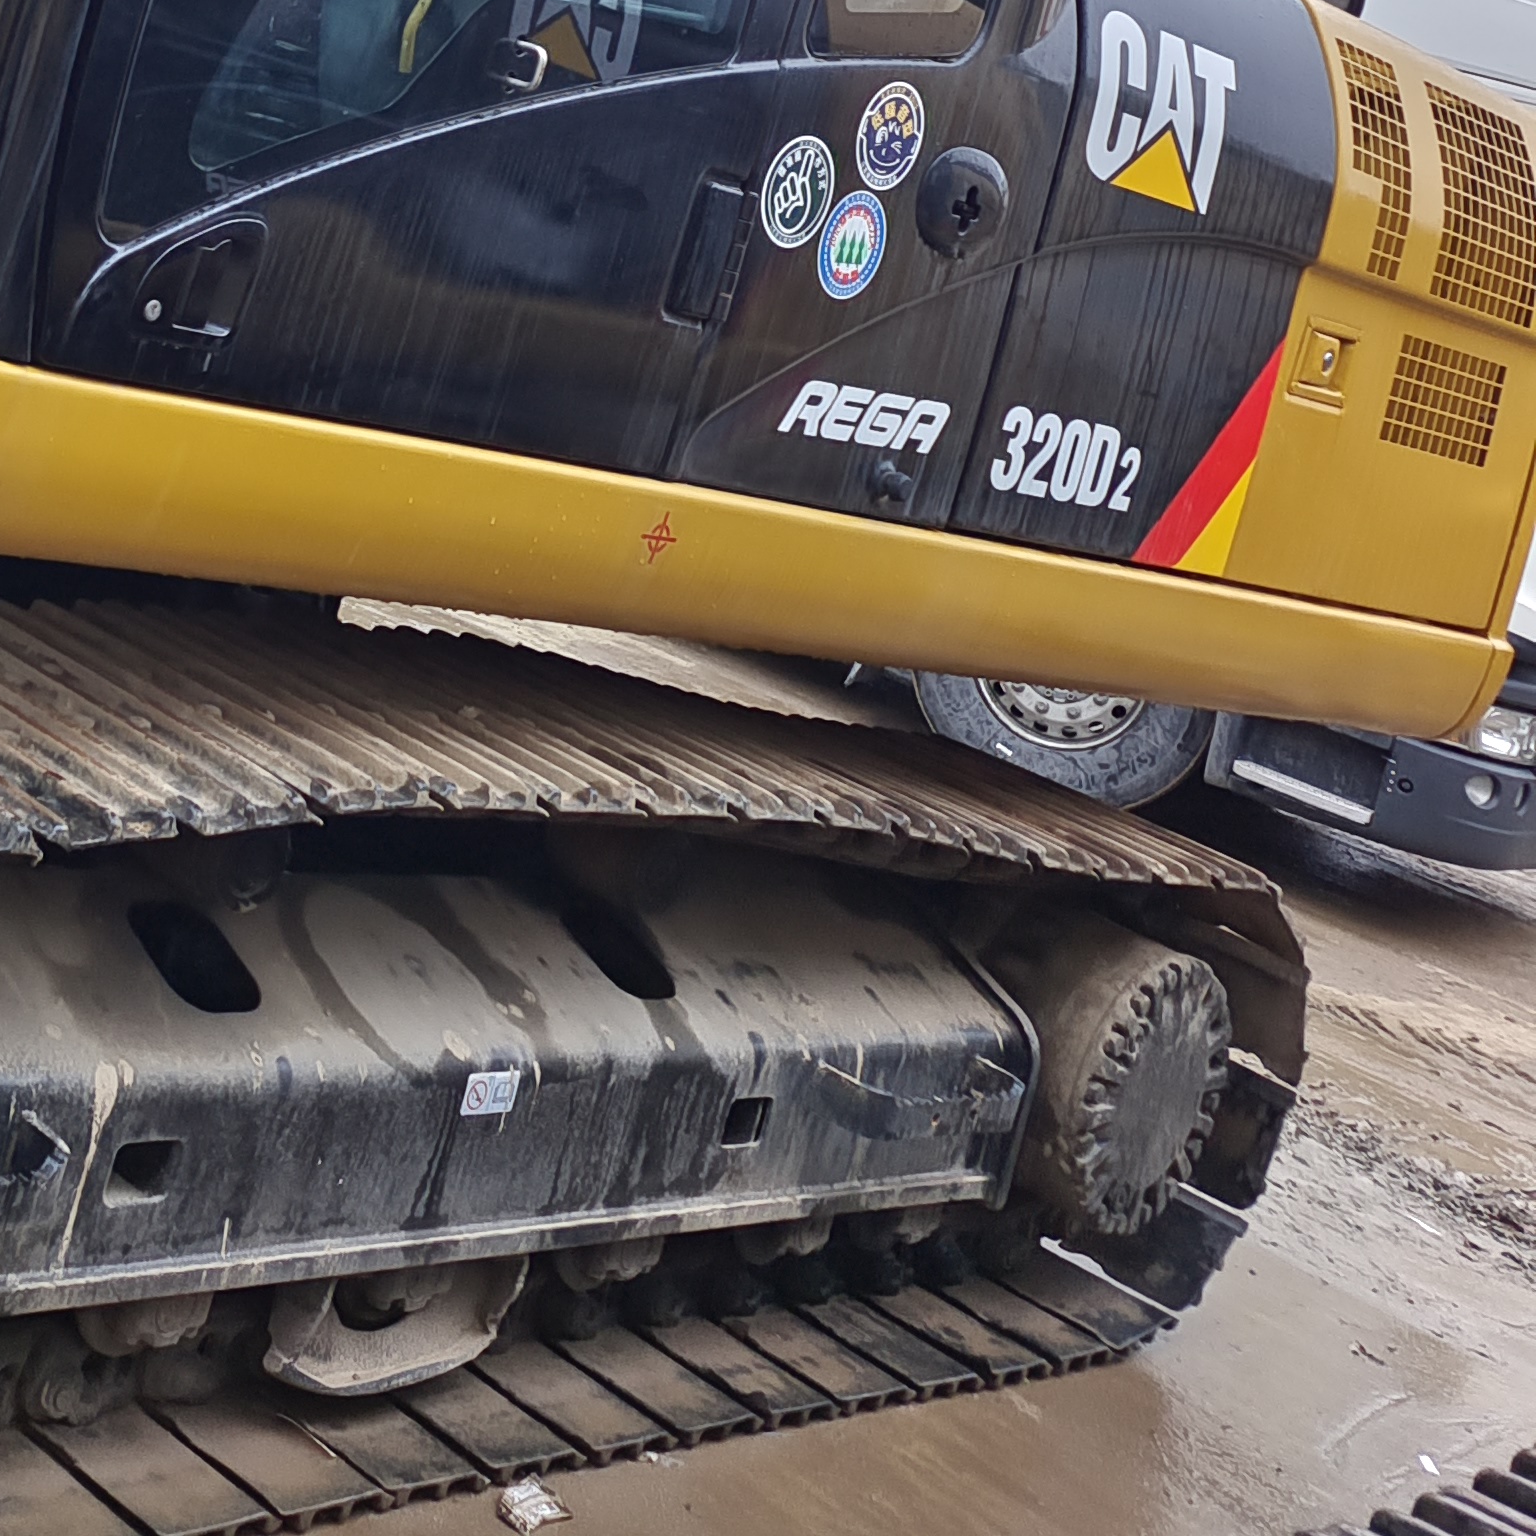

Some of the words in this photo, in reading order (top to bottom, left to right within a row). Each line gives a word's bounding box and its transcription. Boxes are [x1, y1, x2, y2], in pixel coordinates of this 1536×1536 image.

[1086, 10, 1237, 215] CAT
[777, 379, 952, 455] REGA
[990, 405, 1142, 512] 320D2
